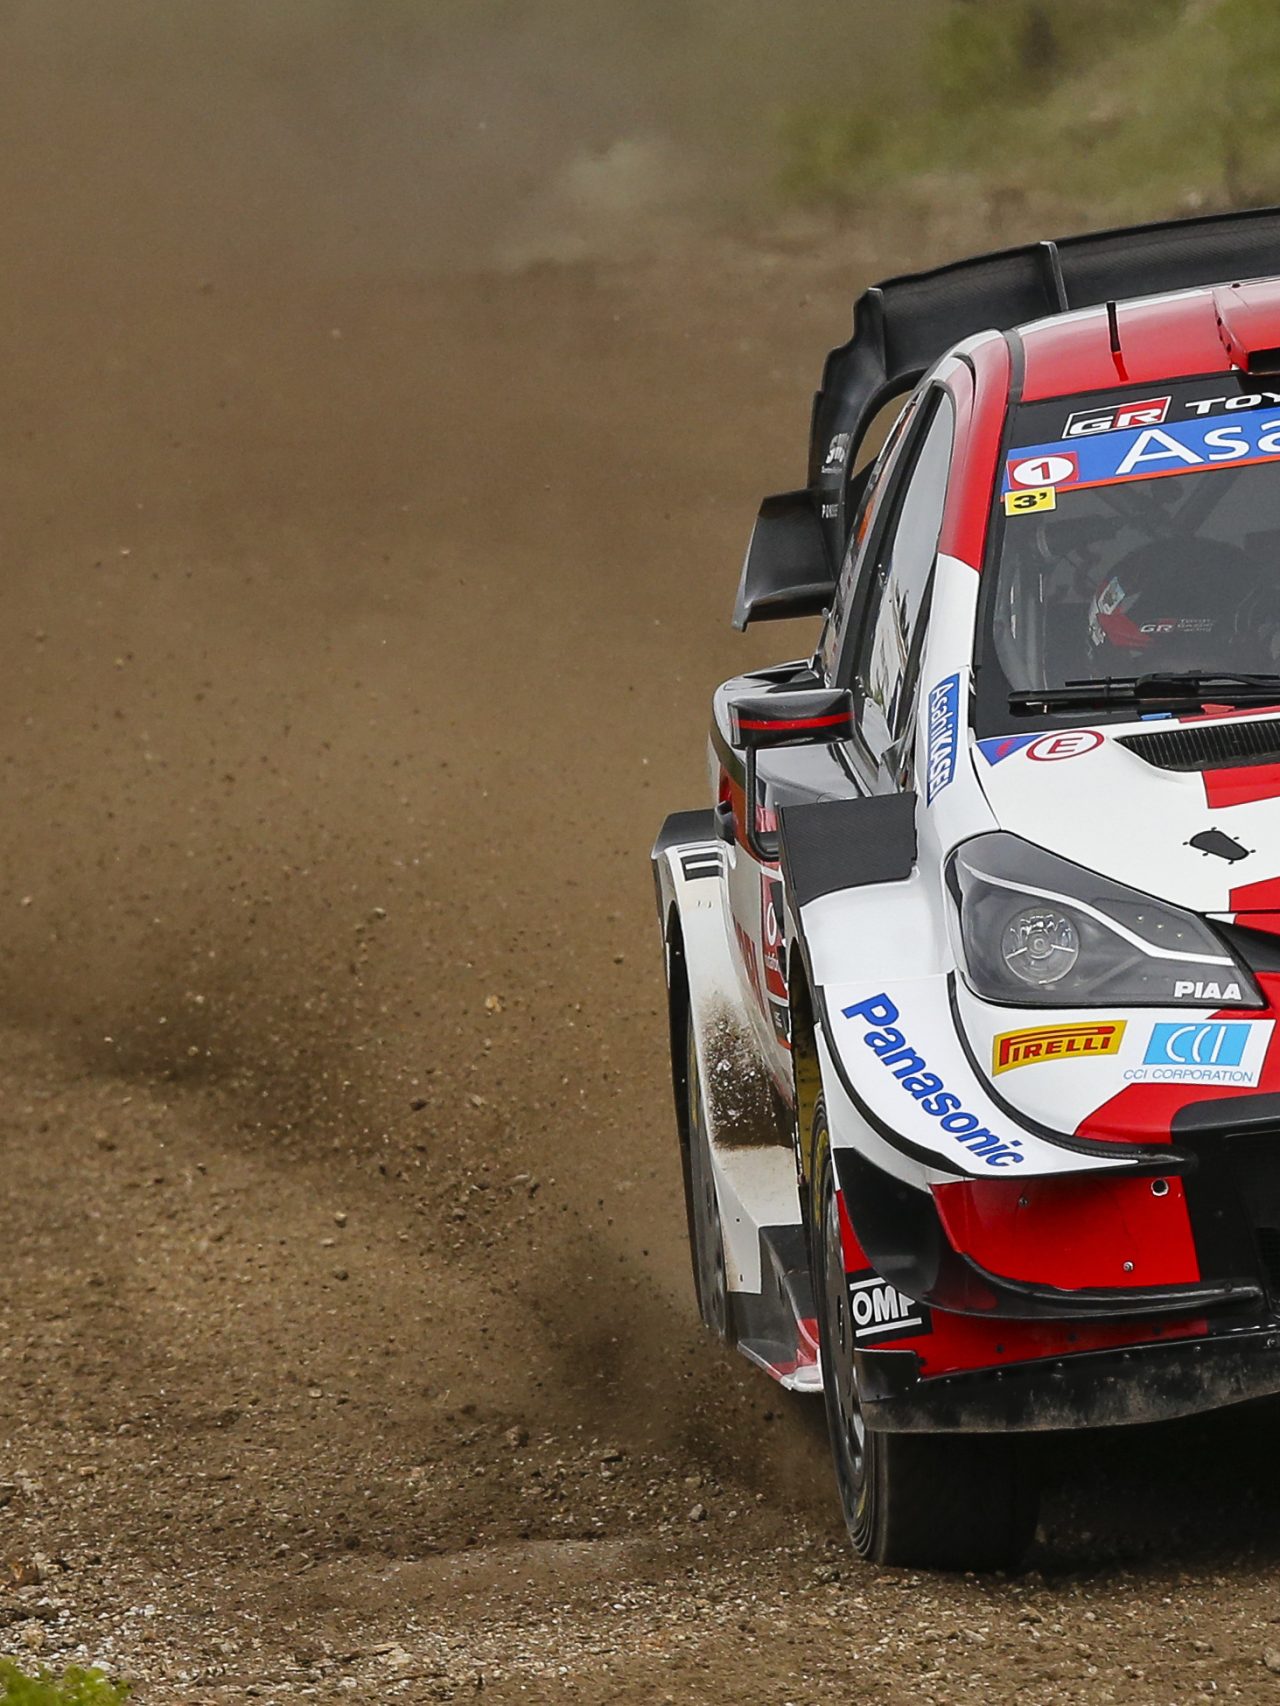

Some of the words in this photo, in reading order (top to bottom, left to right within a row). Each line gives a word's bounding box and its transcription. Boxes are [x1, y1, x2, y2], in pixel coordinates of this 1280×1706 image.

[1070, 407, 1163, 434] GR
[1031, 461, 1051, 480] 1
[1047, 737, 1083, 755] E
[1174, 981, 1242, 1000] PIAA
[999, 1026, 1116, 1066] PIRELLI
[841, 992, 1025, 1168] Panasonic
[1123, 1068, 1150, 1081] CCI
[1152, 1068, 1254, 1083] CORPORATION
